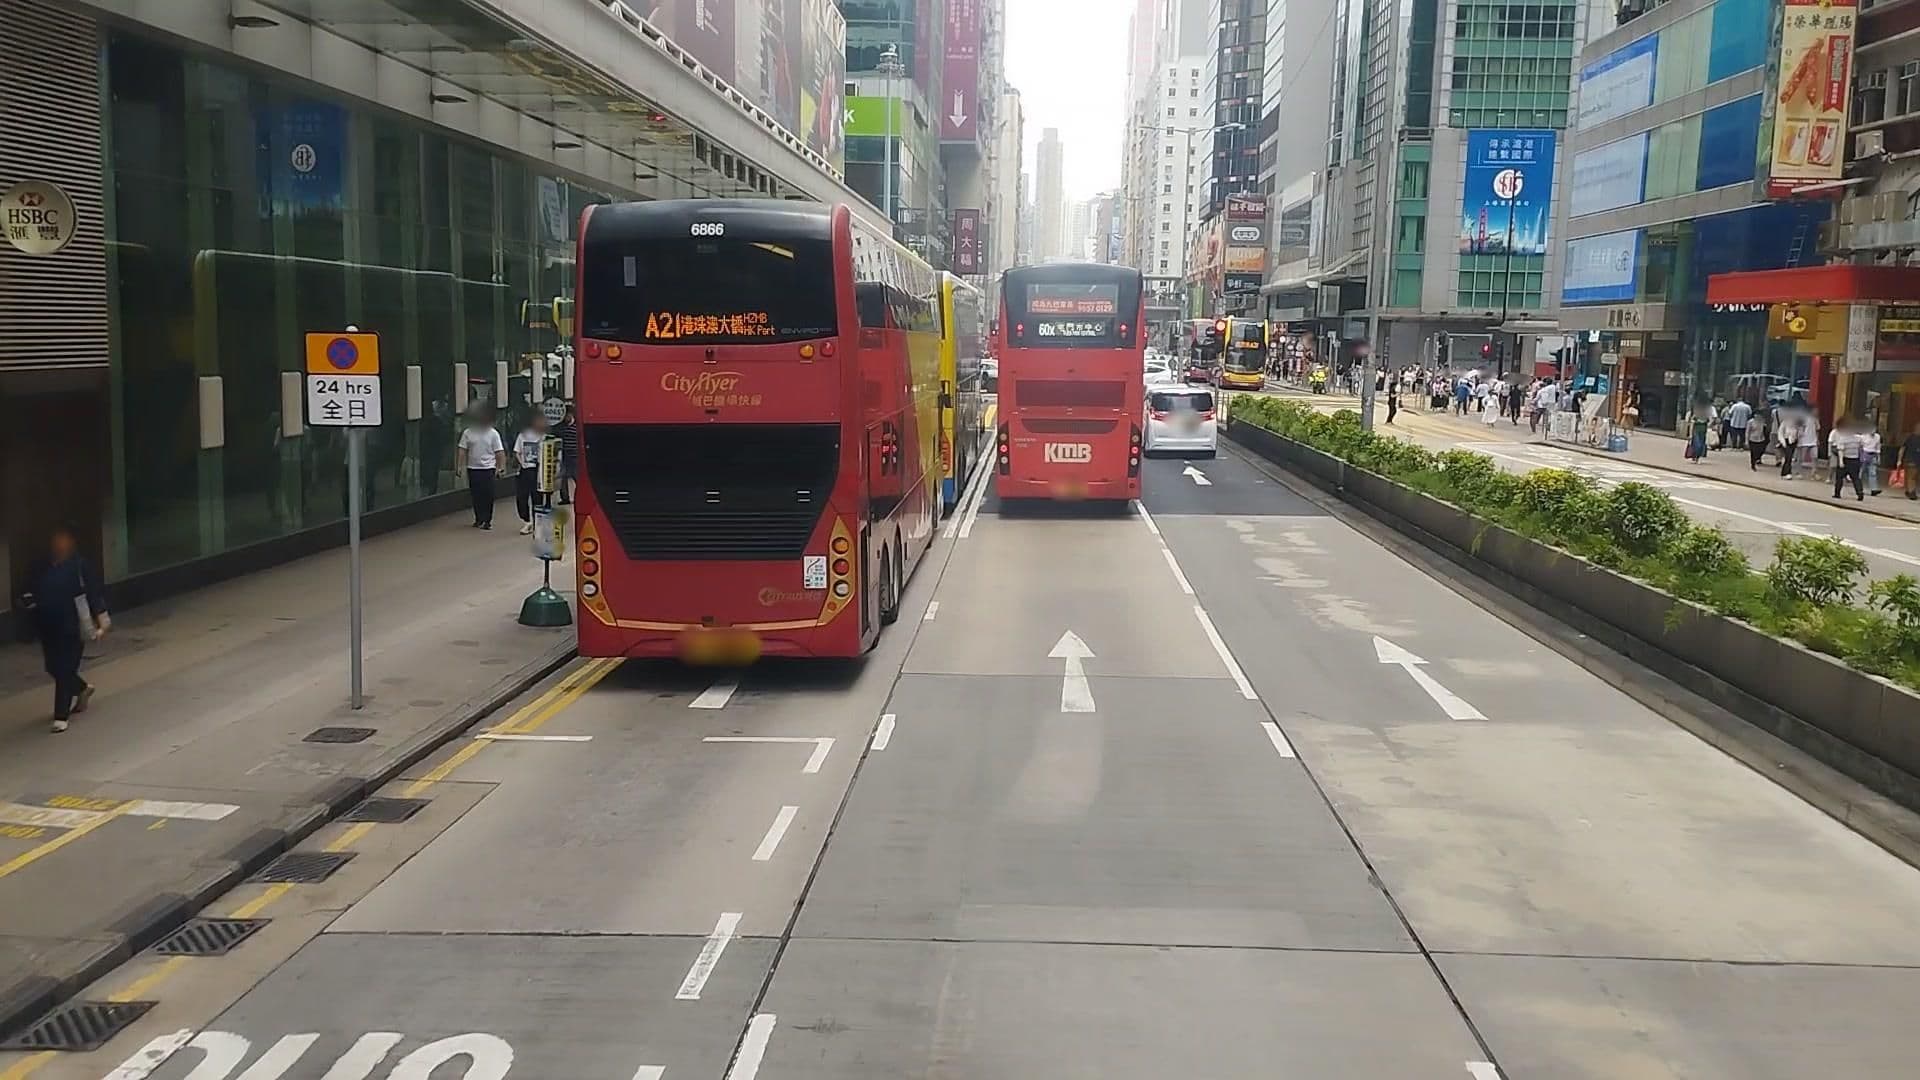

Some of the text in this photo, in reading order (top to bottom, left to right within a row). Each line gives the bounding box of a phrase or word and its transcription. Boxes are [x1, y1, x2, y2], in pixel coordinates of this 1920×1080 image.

[8, 208, 58, 225] HSBC
[691, 223, 724, 236] 6866
[645, 312, 681, 338] A21
[316, 380, 372, 394] 24 hrs
[322, 399, 366, 419] 全日
[1044, 442, 1092, 463] KMB
